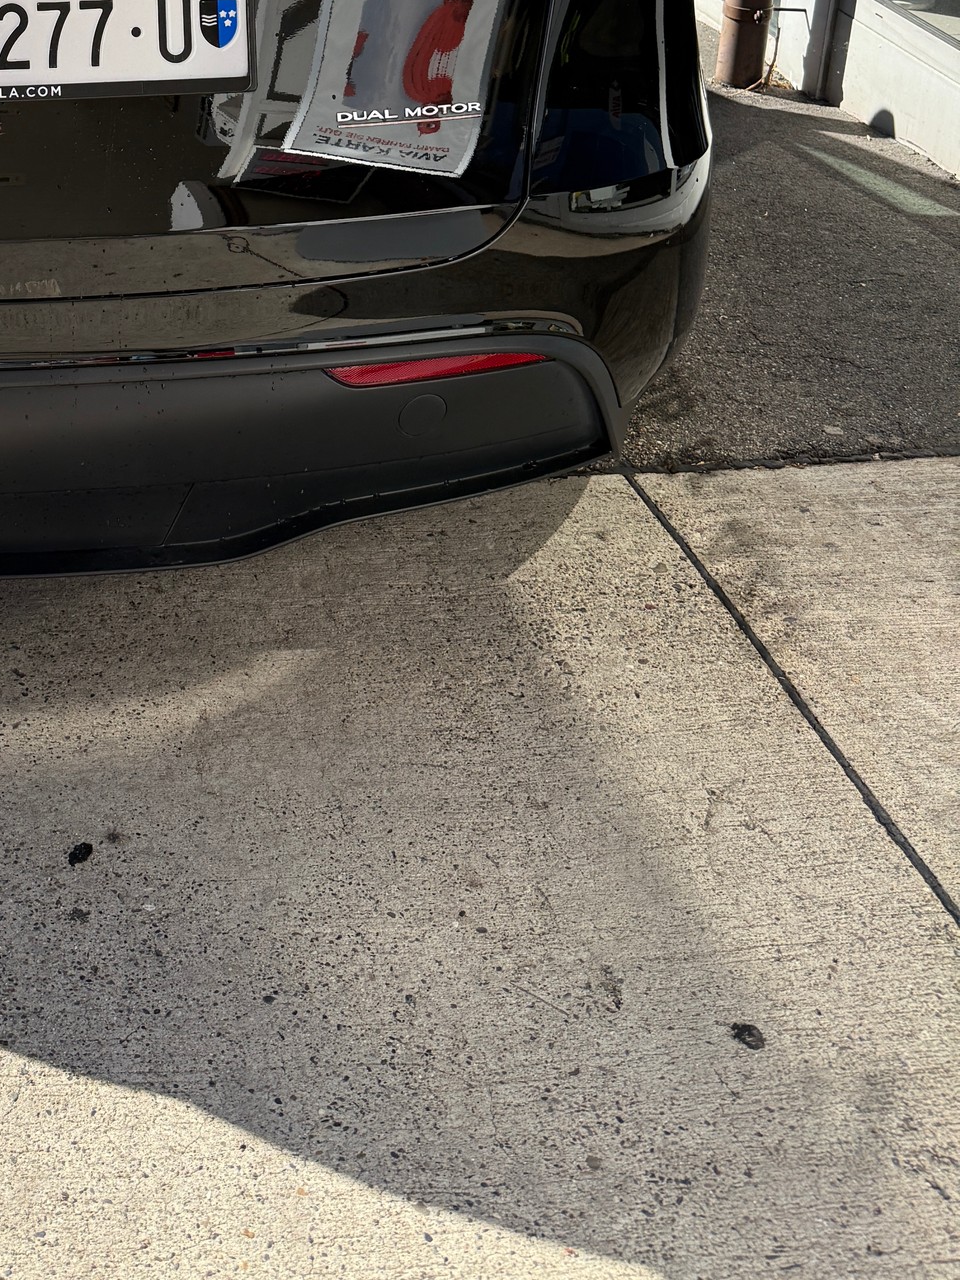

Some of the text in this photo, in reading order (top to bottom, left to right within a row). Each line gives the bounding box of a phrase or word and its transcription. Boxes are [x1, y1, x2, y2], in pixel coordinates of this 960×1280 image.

[336, 101, 482, 124] DUAL MOTOR
[312, 133, 448, 162] AVIA KARTE.
